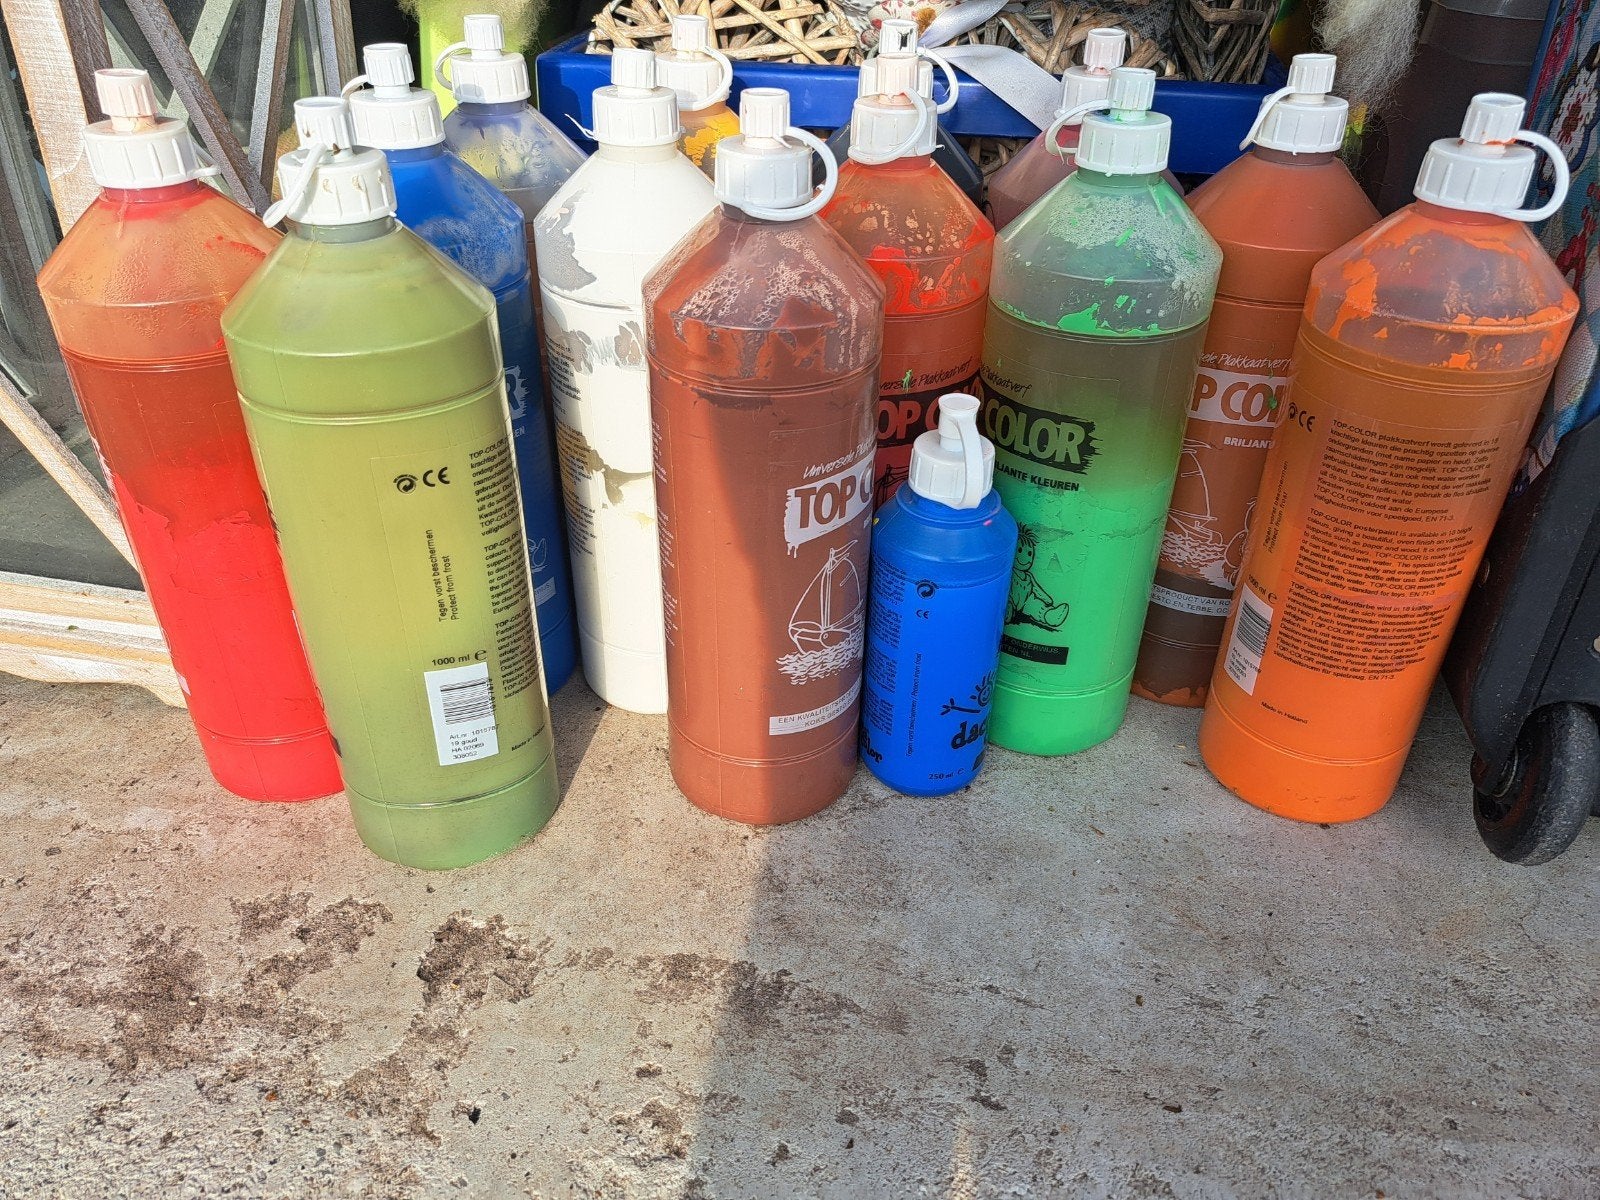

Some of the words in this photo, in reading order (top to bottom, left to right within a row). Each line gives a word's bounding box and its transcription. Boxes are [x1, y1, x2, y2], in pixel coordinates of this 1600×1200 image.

[877, 401, 921, 439] OP
[985, 399, 1086, 464] COLOR
[1330, 428, 1360, 443] krachtige
[1361, 438, 1389, 450] kleuren
[1403, 447, 1435, 457] prachtig
[1333, 419, 1378, 439] TOP-COLOR
[1378, 433, 1430, 447] plakkaatverf
[1430, 440, 1452, 448] wordt
[1325, 445, 1388, 467] raamschilderingen
[1441, 464, 1484, 474] TOP-COLOR
[1328, 437, 1374, 456] ondergronden
[1375, 450, 1393, 460] (met
[1394, 454, 1416, 462] name
[1416, 457, 1441, 465] papier
[1030, 475, 1080, 492] KLEUREN
[1351, 471, 1368, 480] Door
[1369, 468, 1388, 476] maar
[795, 475, 856, 529] TOP
[1316, 484, 1359, 504] TOP-COLOR
[1360, 500, 1387, 511] voldoet
[1345, 488, 1374, 499] reinigen
[1310, 507, 1353, 528] TOP-COLOR
[1353, 524, 1399, 537] posterpaint
[1366, 510, 1383, 518] voor
[1305, 524, 1333, 538] supports
[1333, 534, 1351, 544] such
[1332, 526, 1354, 537] giving
[426, 529, 440, 577] beschermen
[1299, 545, 1310, 553] the
[1310, 552, 1327, 561] paint
[1348, 563, 1380, 573] smoothly
[1309, 542, 1320, 550] can
[1331, 549, 1355, 560] diluted
[1310, 534, 1338, 548] decorate
[1375, 551, 1422, 560] TOP-COLOR
[441, 555, 451, 573] frost
[1342, 568, 1363, 578] Close
[433, 578, 444, 597] vorst
[446, 575, 455, 593] from
[1294, 566, 1323, 583] European
[1324, 578, 1347, 590] Safety
[1347, 586, 1379, 596] standard
[1304, 564, 1330, 577] cleaned
[1330, 573, 1345, 581] with
[1370, 582, 1416, 591] TOP-COLOR
[1290, 580, 1332, 601] TOP-COLOR
[437, 598, 448, 622] Tegen
[448, 593, 460, 620] Protect
[1285, 602, 1297, 611] und
[1317, 615, 1335, 624] Auch
[1336, 620, 1379, 633] Verwendung
[1301, 625, 1318, 635] auch
[1310, 620, 1355, 636] TOP-COLOR
[1275, 642, 1315, 663] TOP-COLOR
[1315, 659, 1349, 673] entspricht
[1303, 640, 1329, 653] Flasche
[432, 656, 456, 666] 1000
[458, 654, 471, 662] ml
